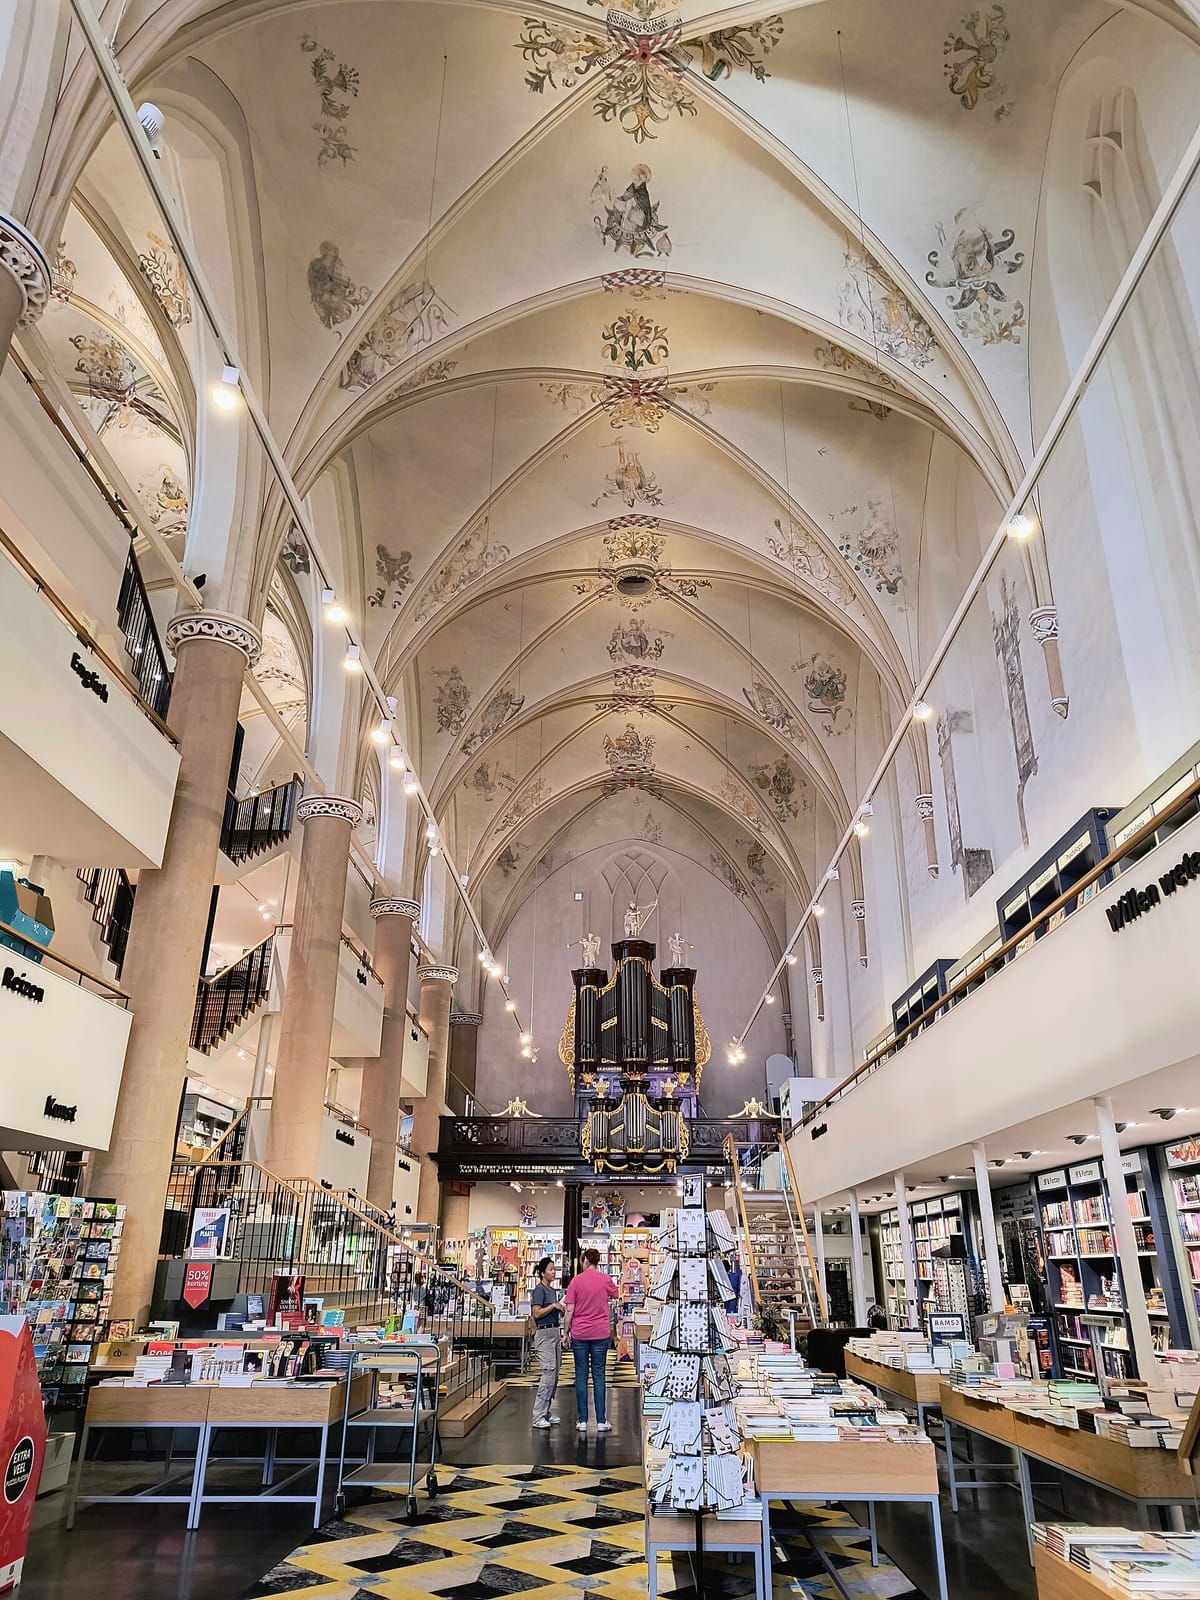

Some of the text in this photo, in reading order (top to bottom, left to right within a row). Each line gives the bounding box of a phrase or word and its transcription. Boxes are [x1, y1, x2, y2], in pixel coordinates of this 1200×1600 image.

[70, 651, 109, 704] English
[1105, 886, 1161, 933] Willen
[1, 966, 45, 1003] Reizen
[44, 1094, 78, 1123] Kunst
[188, 1270, 210, 1281] 50%
[13, 1448, 31, 1465] EXTRA
[13, 1462, 26, 1476] VEEL
